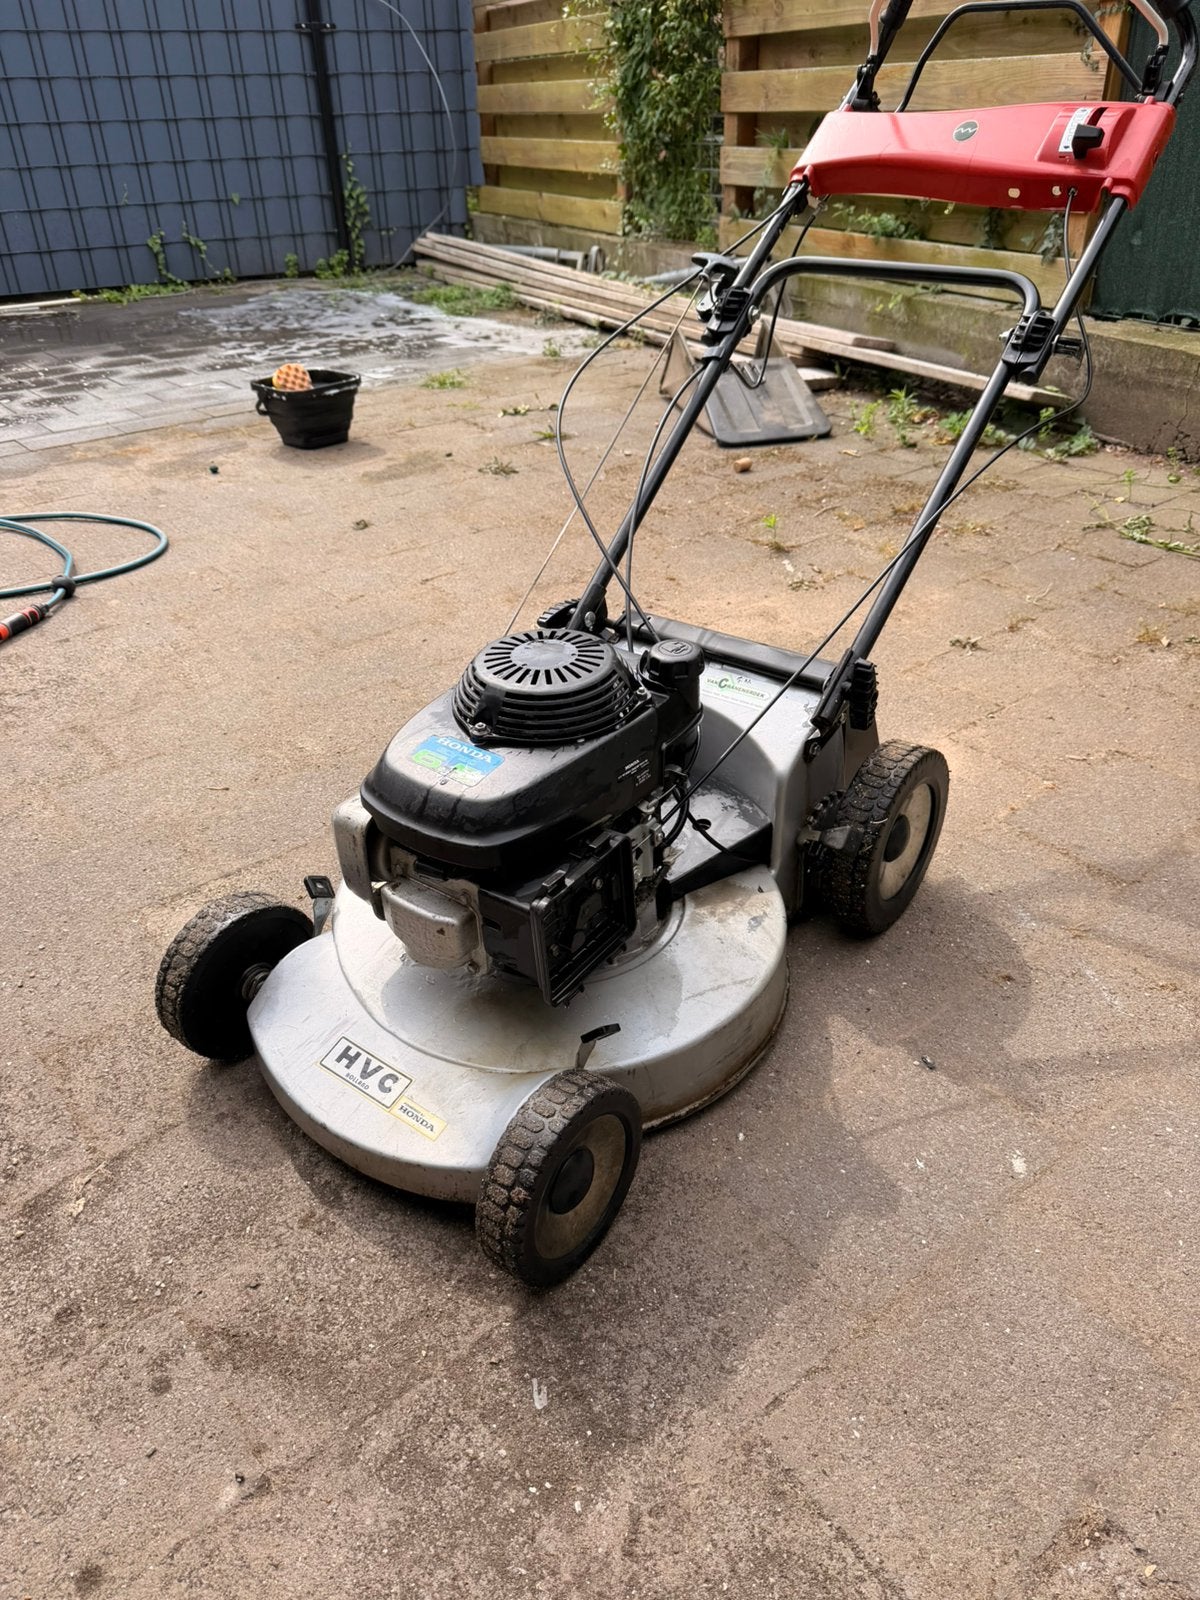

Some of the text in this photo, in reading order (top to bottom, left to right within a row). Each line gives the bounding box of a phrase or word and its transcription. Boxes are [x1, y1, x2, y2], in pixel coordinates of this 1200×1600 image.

[438, 738, 492, 763] HONDA
[334, 1045, 399, 1094] HVC
[399, 1104, 435, 1132] HONDA
